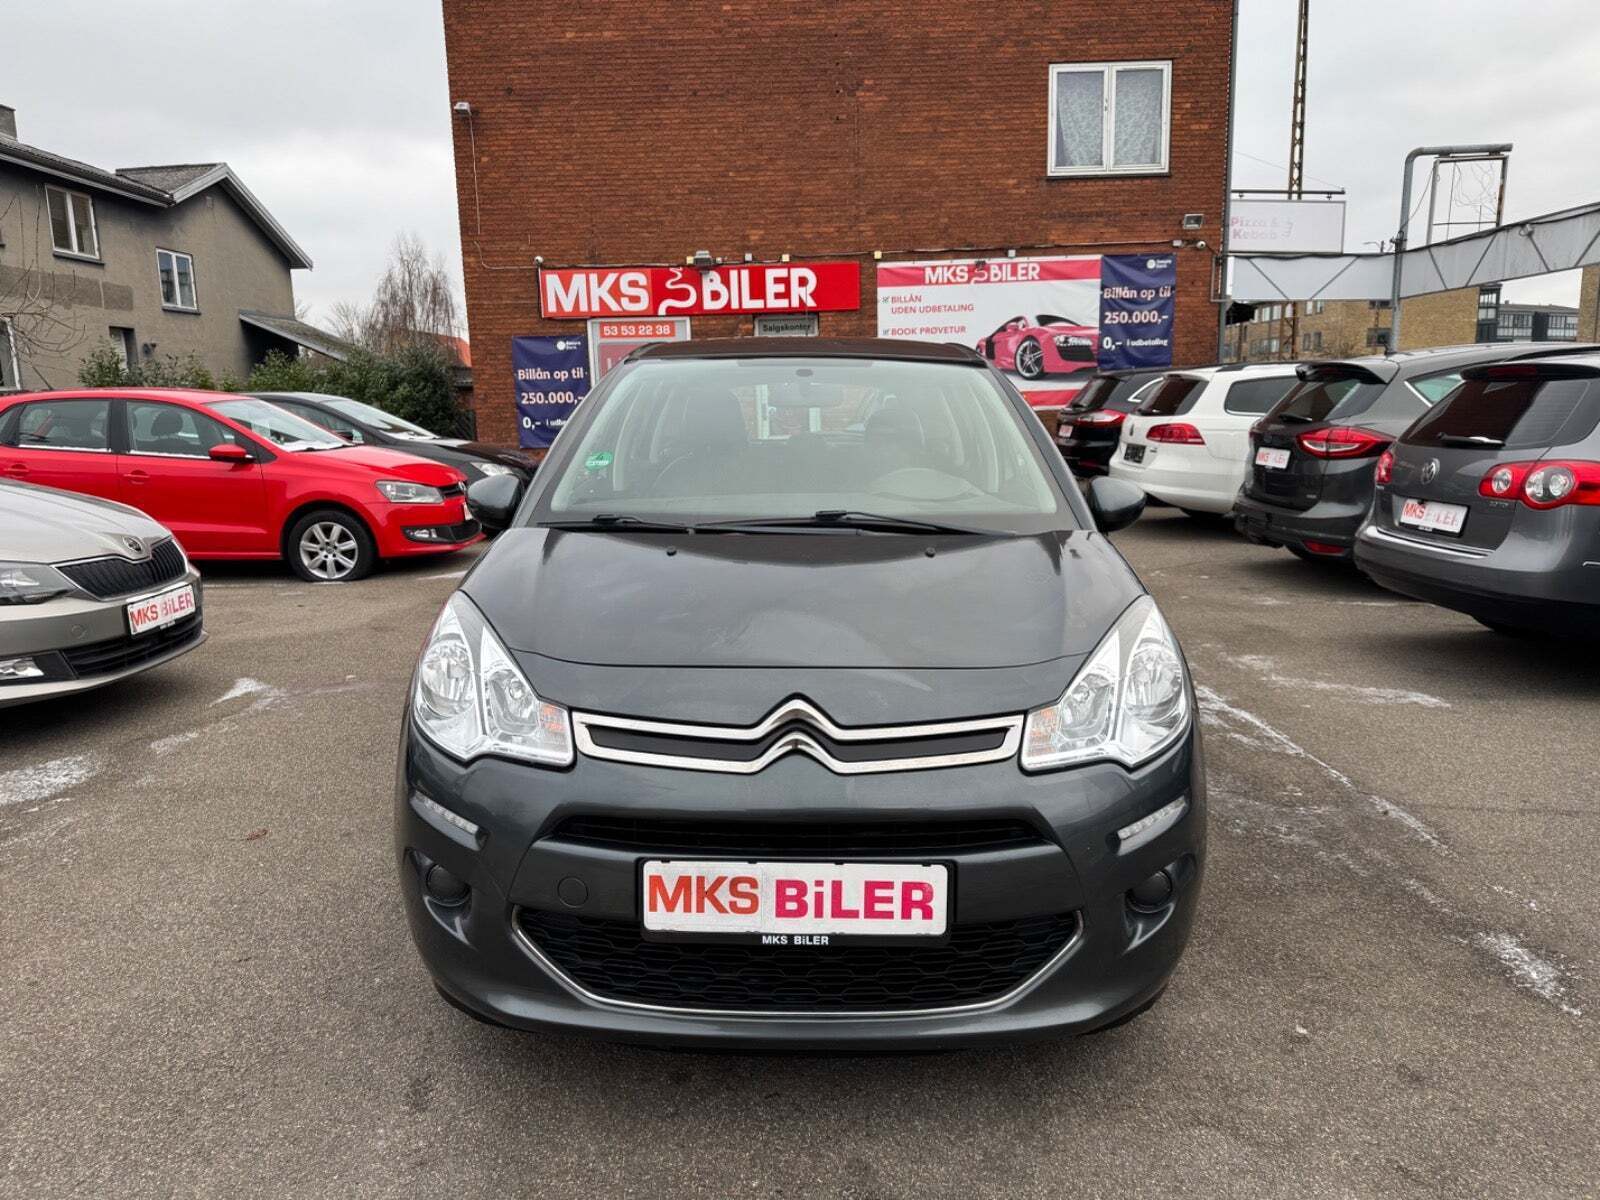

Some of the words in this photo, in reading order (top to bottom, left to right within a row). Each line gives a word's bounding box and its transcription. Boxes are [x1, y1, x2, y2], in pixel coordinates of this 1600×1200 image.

[925, 266, 969, 285] MKS
[990, 262, 1041, 282] BILER
[545, 271, 650, 313] MKS
[702, 267, 818, 310] BILER
[1103, 286, 1137, 299] Billån
[1140, 289, 1156, 301] op
[1159, 285, 1171, 297] til
[891, 294, 922, 304] BILLÅN
[891, 306, 917, 314] UDEN
[919, 303, 974, 313] UDBETALING
[603, 325, 618, 336] 53
[621, 325, 636, 336] 53
[638, 325, 653, 335] 22
[891, 327, 917, 336] BOOK
[517, 367, 551, 380] Billån
[553, 370, 569, 382] op
[571, 367, 584, 379] til
[1404, 502, 1426, 519] MKS
[130, 604, 158, 627] MKS
[648, 874, 760, 915] MKS
[774, 879, 935, 920] BiLER
[761, 935, 788, 945] MKS
[793, 935, 829, 946] BiLER
